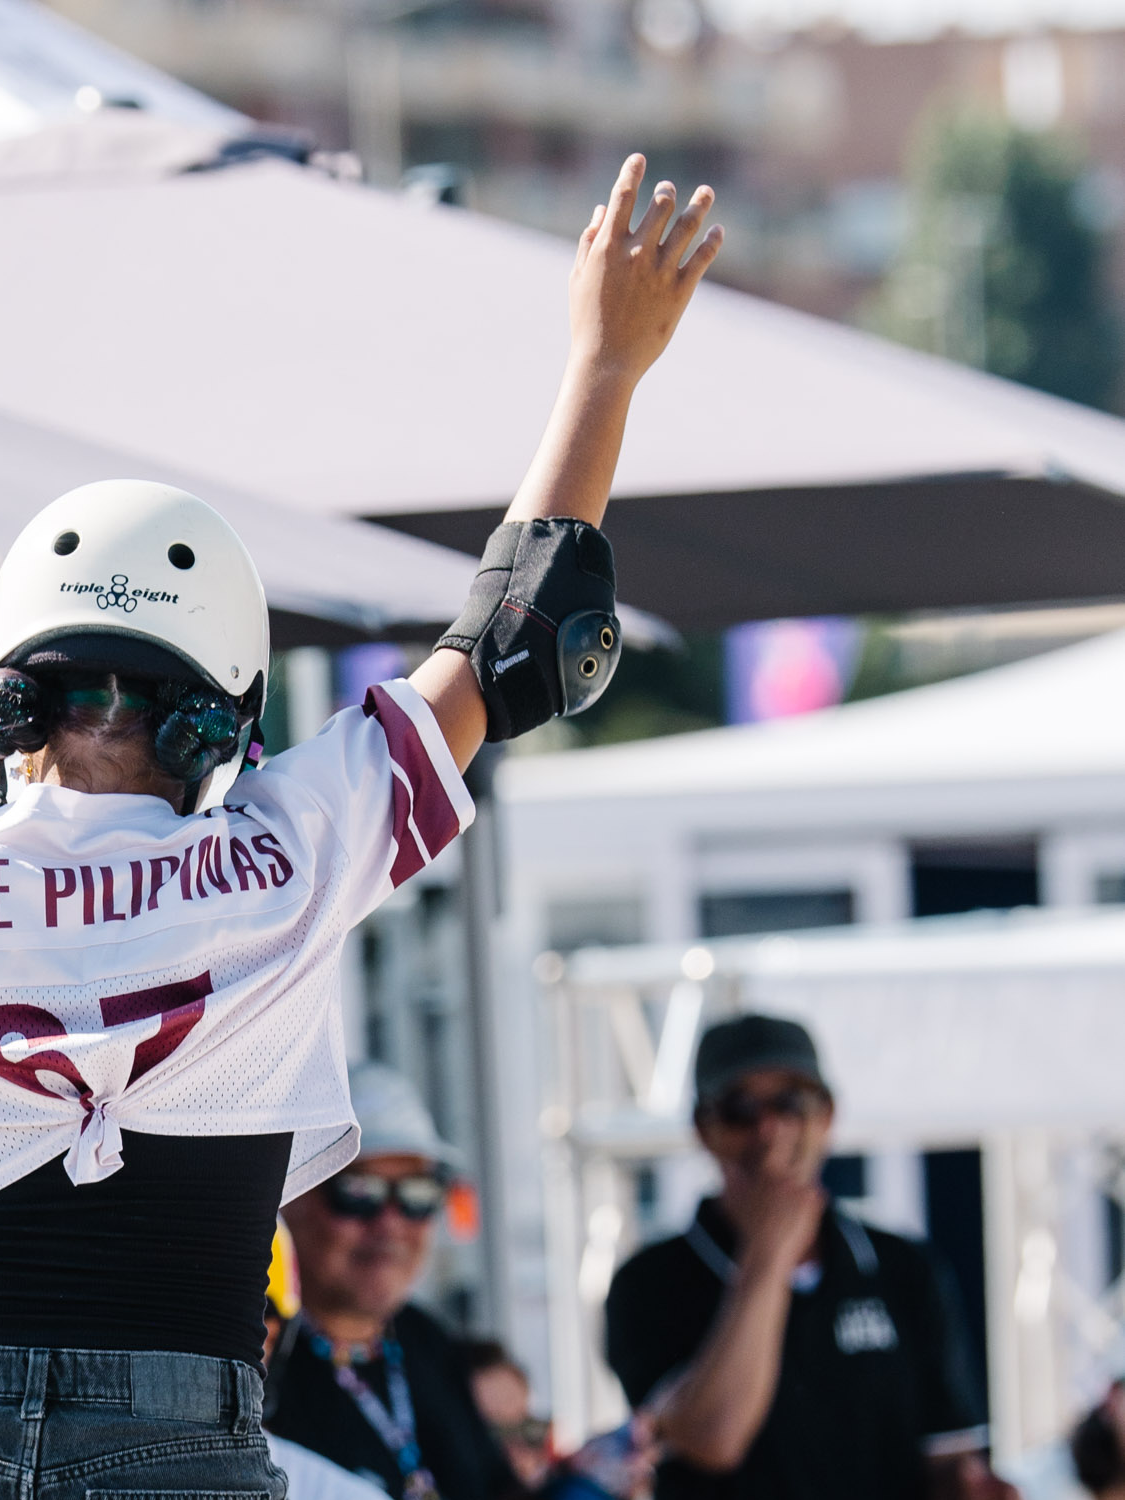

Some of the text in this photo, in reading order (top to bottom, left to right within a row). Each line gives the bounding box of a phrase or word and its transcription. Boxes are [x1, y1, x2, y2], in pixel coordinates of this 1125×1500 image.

[60, 582, 180, 605] triple eight
[42, 832, 295, 928] PILIPINAS
